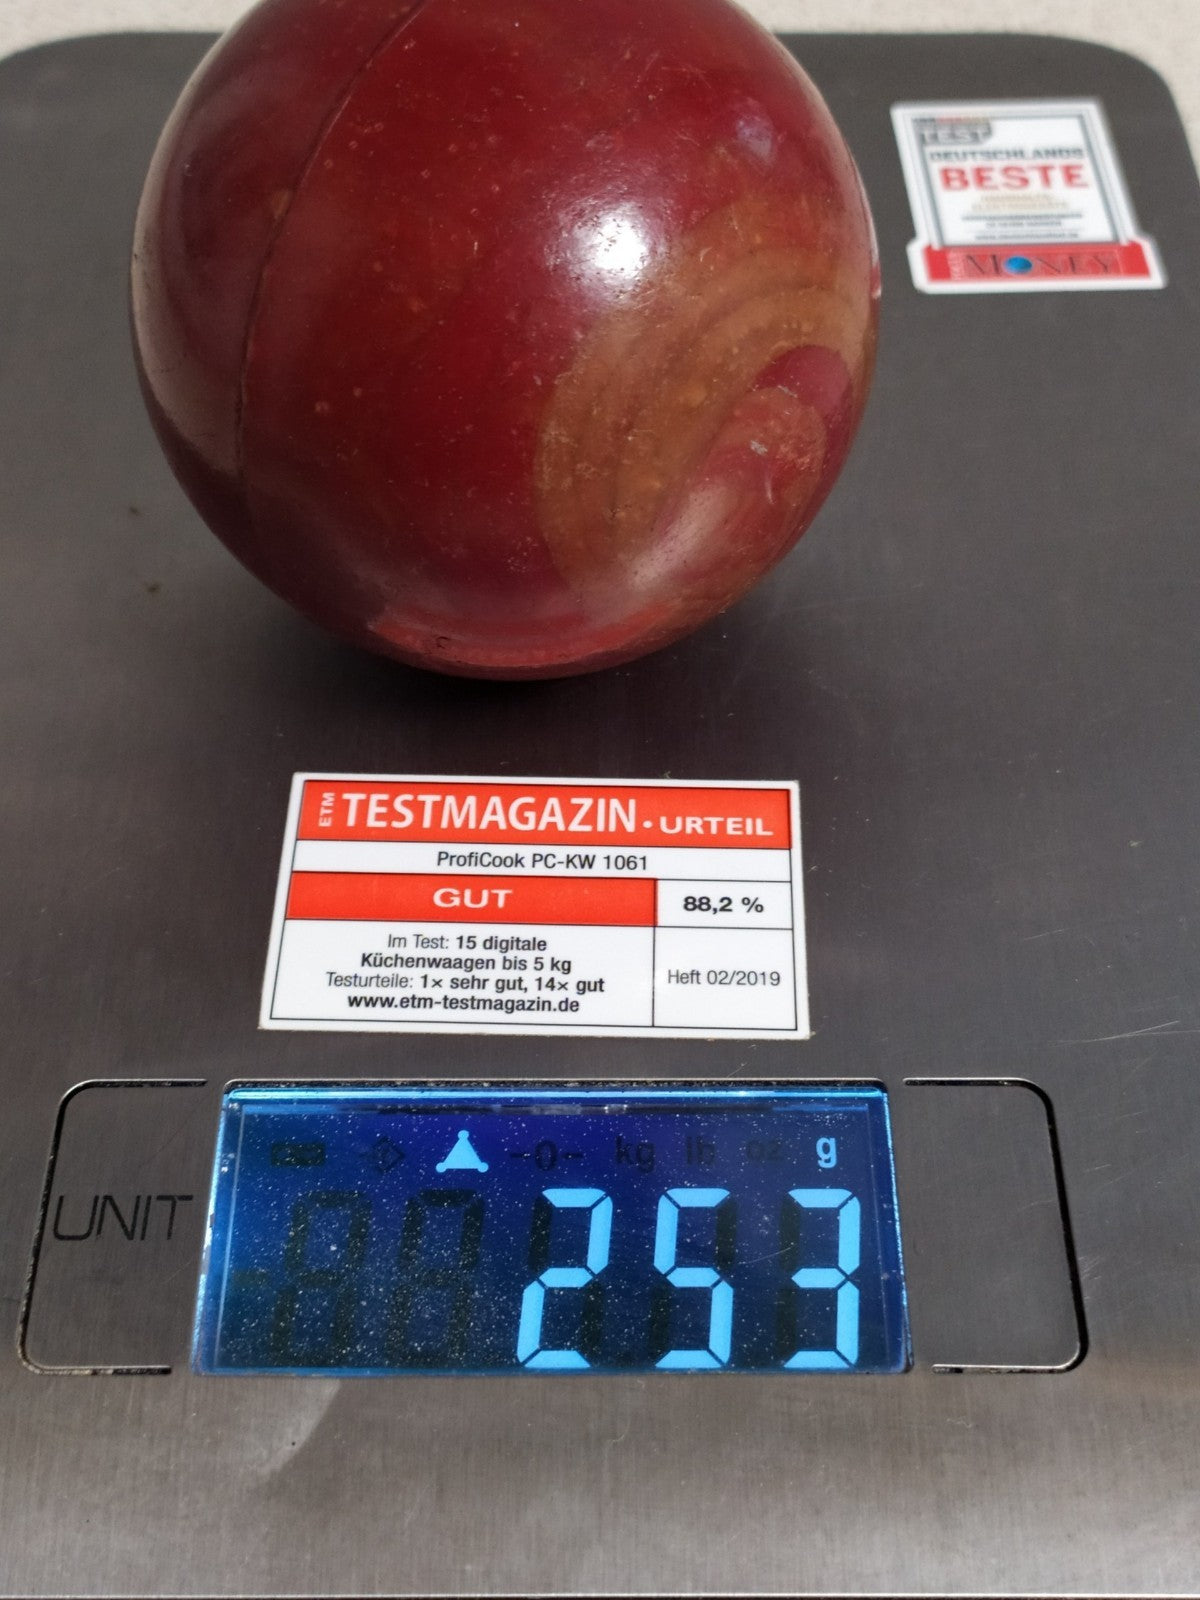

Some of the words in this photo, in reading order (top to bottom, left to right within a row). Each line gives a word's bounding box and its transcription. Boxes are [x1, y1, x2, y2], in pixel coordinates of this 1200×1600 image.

[929, 147, 1086, 163] DEUTSCHLANDS
[939, 164, 1089, 190] BESTE
[318, 792, 335, 827] ETM
[341, 793, 637, 833] TESTMAGAZIN
[659, 816, 774, 836] URTEIL
[436, 851, 526, 869] ProfiCook
[531, 853, 596, 870] PC-KW
[603, 855, 648, 870] 1061
[432, 887, 513, 909] GUT
[683, 896, 733, 915] 88,2
[741, 896, 764, 913] %
[387, 934, 407, 949] Im
[413, 934, 450, 950] Test:
[456, 935, 477, 950] 15
[482, 935, 548, 954] digitale
[360, 952, 496, 973] Küchenwaagen
[502, 955, 528, 971] bis
[533, 957, 545, 971] 5
[550, 957, 572, 974] kg
[326, 971, 413, 988] Testurteile:
[449, 974, 490, 990] sehr
[495, 976, 529, 993] gut,
[575, 978, 605, 995] gut
[667, 969, 701, 984] Heft
[706, 970, 782, 986] 02/2019
[347, 993, 580, 1014] www.etm-testmagazin.de
[815, 1135, 838, 1169] g
[52, 1194, 194, 1241] UNIT
[516, 1187, 862, 1370] 253
